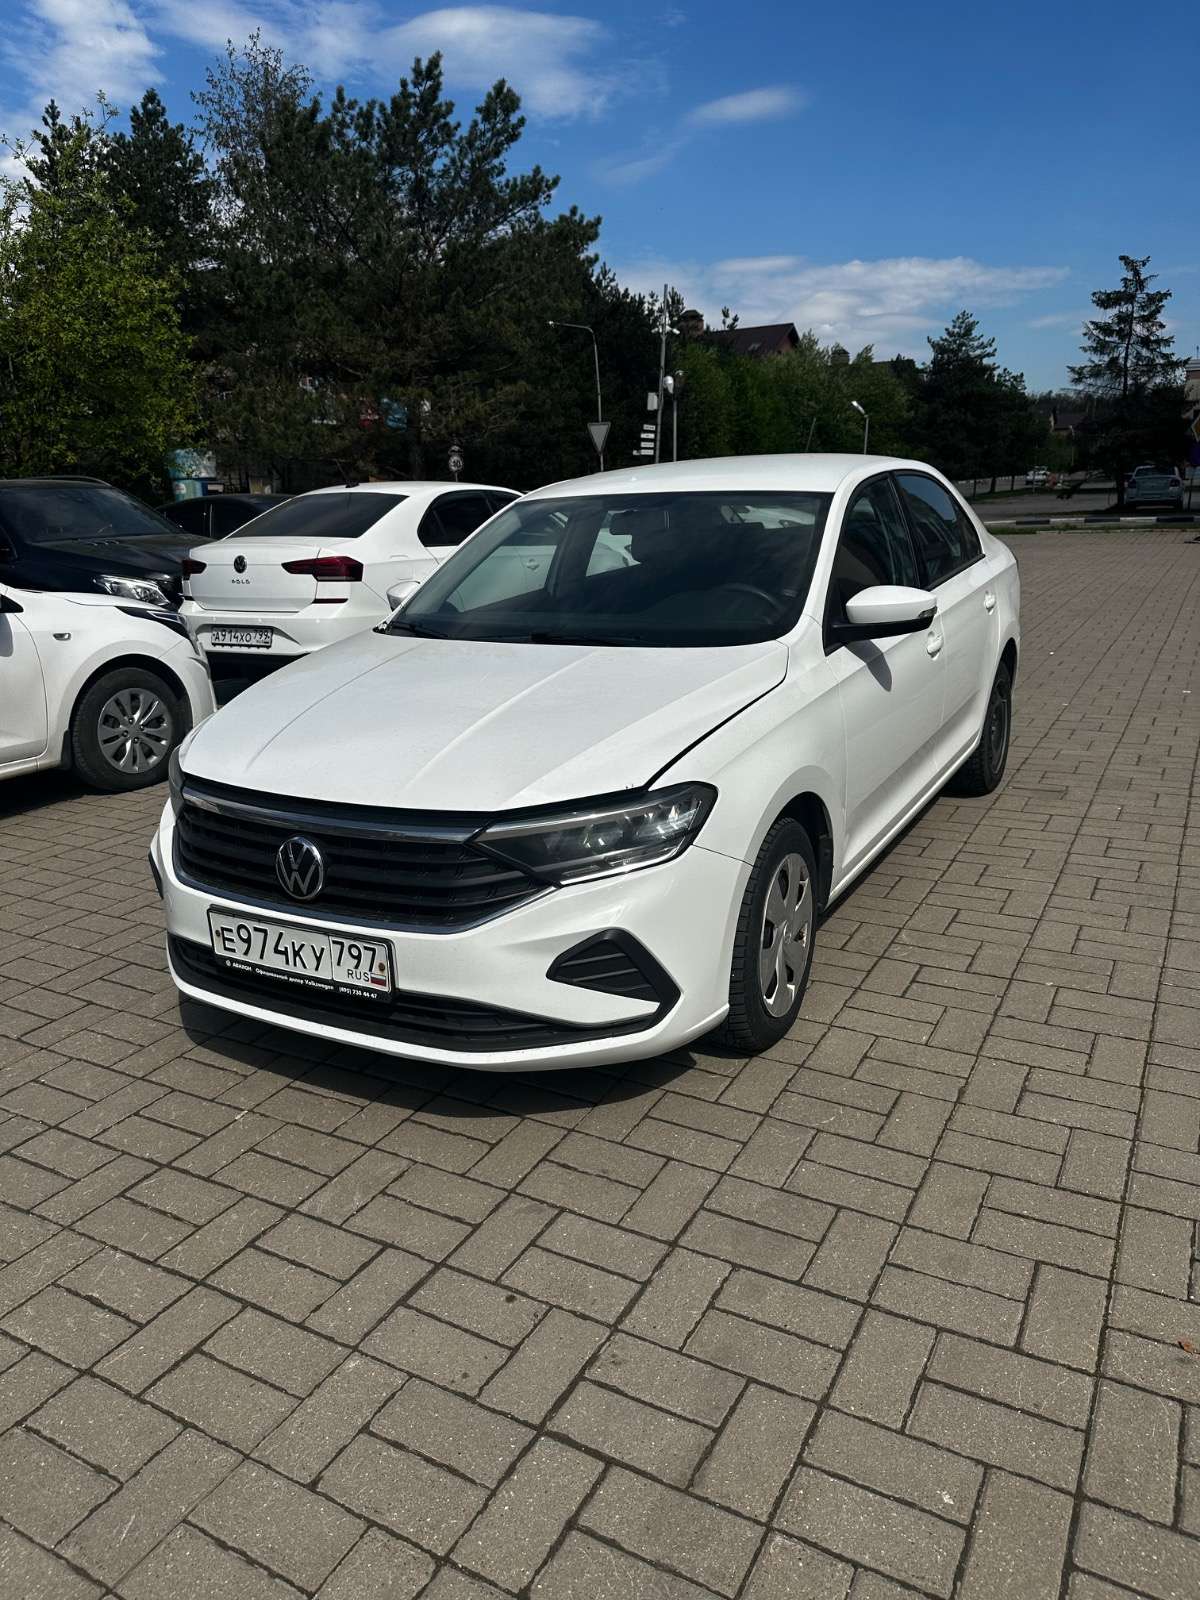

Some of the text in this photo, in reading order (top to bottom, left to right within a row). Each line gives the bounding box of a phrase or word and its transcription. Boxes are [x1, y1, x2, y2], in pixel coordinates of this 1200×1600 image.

[214, 629, 252, 643] А914ХО
[220, 923, 377, 972] Е974КУ 797
[347, 968, 369, 983] RUS
